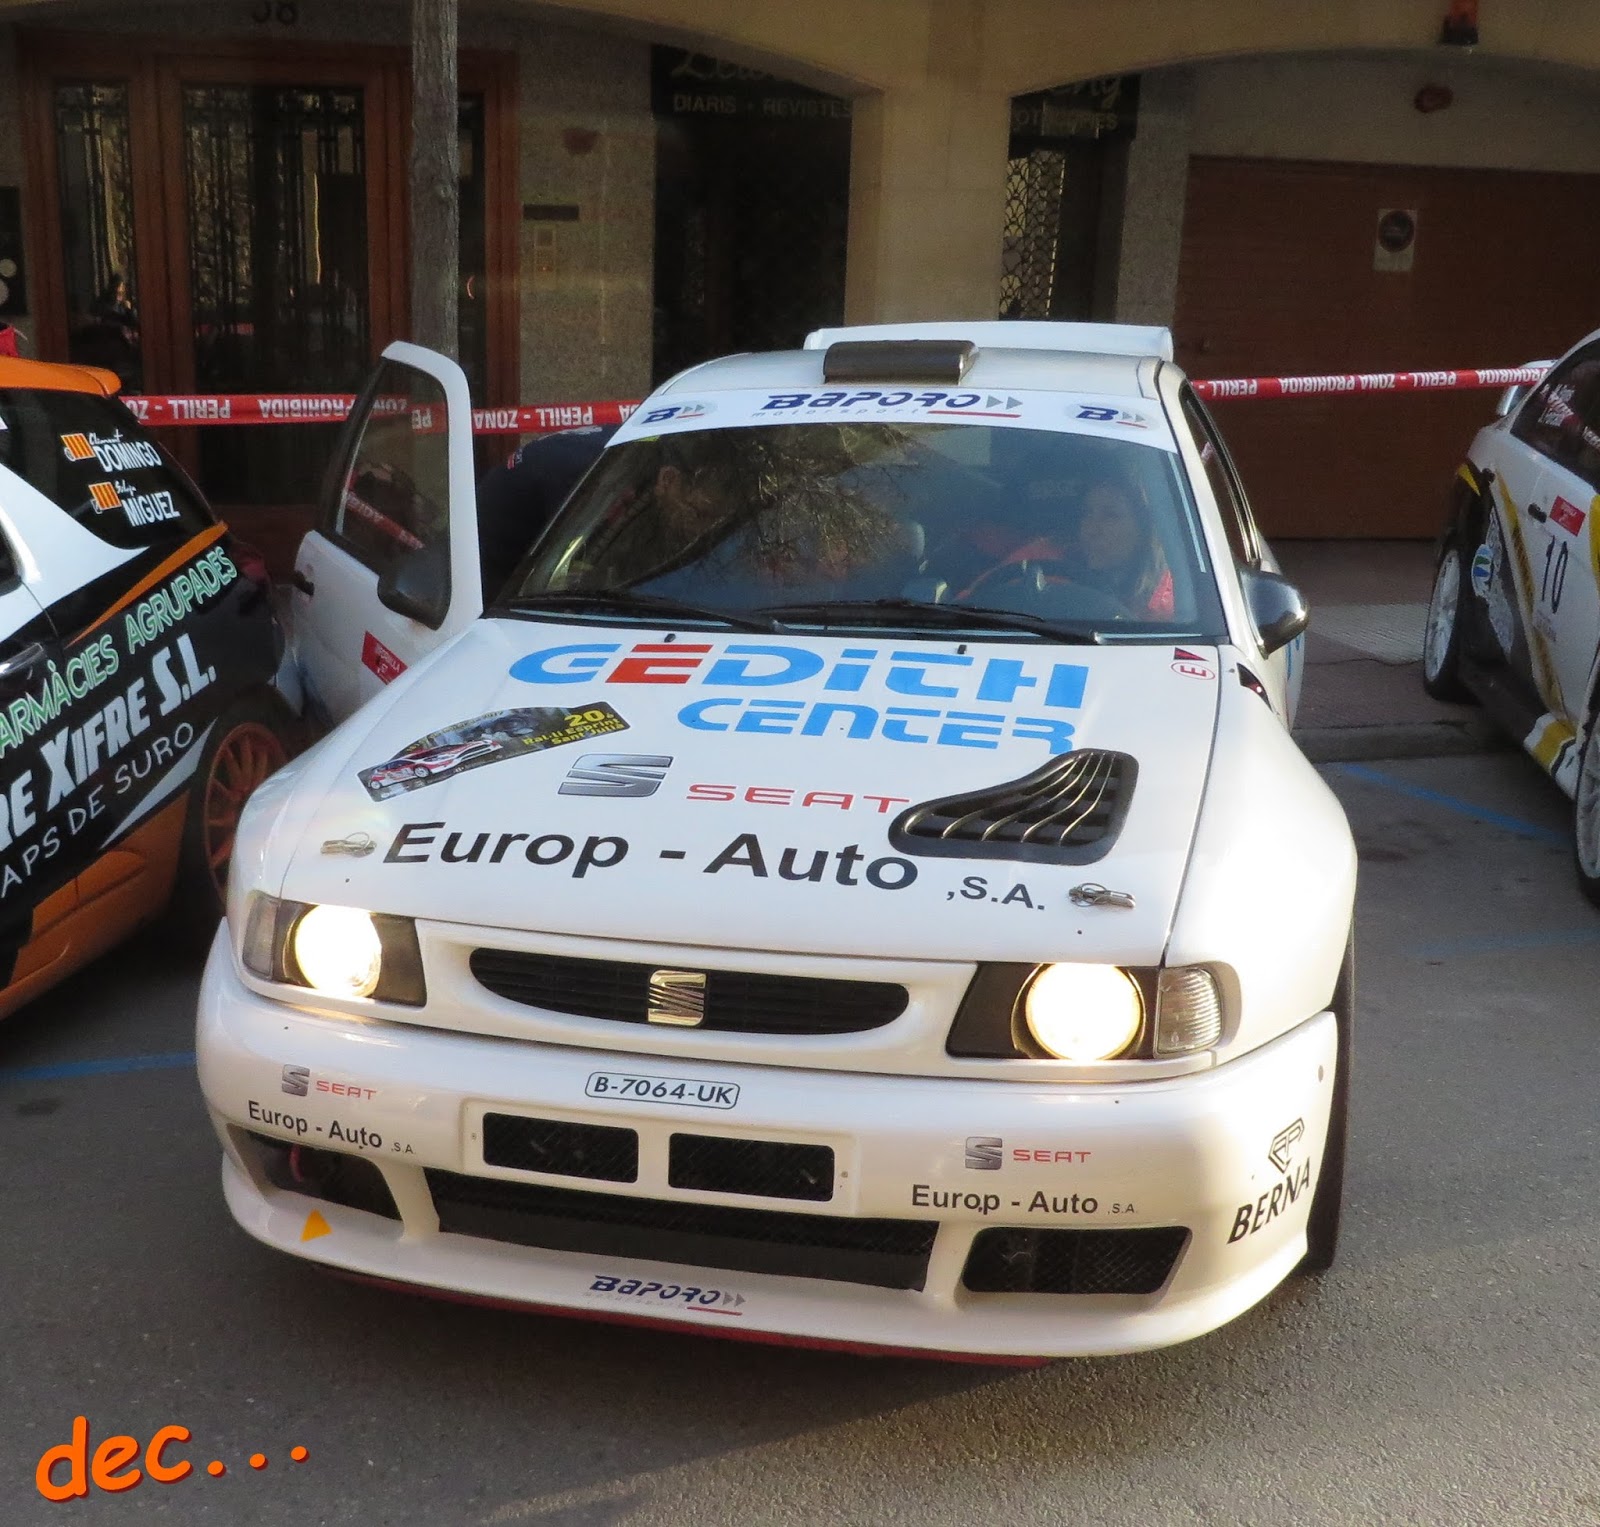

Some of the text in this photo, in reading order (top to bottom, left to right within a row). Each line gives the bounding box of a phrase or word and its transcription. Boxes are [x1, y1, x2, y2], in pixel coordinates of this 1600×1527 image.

[673, 94, 736, 114] DIARIS
[1207, 379, 1258, 396] PERILL
[1278, 375, 1355, 393] PROHIBIDA
[1359, 373, 1396, 390] ZONA
[1408, 371, 1456, 387] PERILL
[168, 399, 231, 419] PERILL
[473, 409, 518, 429] ZONA
[535, 406, 593, 426] PERILL
[751, 408, 920, 418] motorsport
[92, 440, 163, 473] DOMINGO
[1541, 534, 1569, 614] 10
[125, 545, 238, 655] AGRUPADES
[40, 677, 151, 813] XIFRE
[152, 632, 217, 717] S.L.
[550, 730, 585, 745] Sant
[68, 784, 106, 836] DE
[115, 722, 194, 795] SURO
[685, 783, 910, 813] SEAT
[382, 821, 629, 879] Europ
[702, 832, 918, 891] Auto
[315, 1080, 377, 1100] SEAT
[593, 1076, 735, 1104] B-7064-UK
[248, 1099, 308, 1136] Europ
[328, 1119, 383, 1149] Auto
[1013, 1149, 1092, 1163] SEAT
[912, 1183, 1001, 1215] Europ
[1028, 1190, 1099, 1214] Auto
[1226, 1156, 1311, 1245] BERNA
